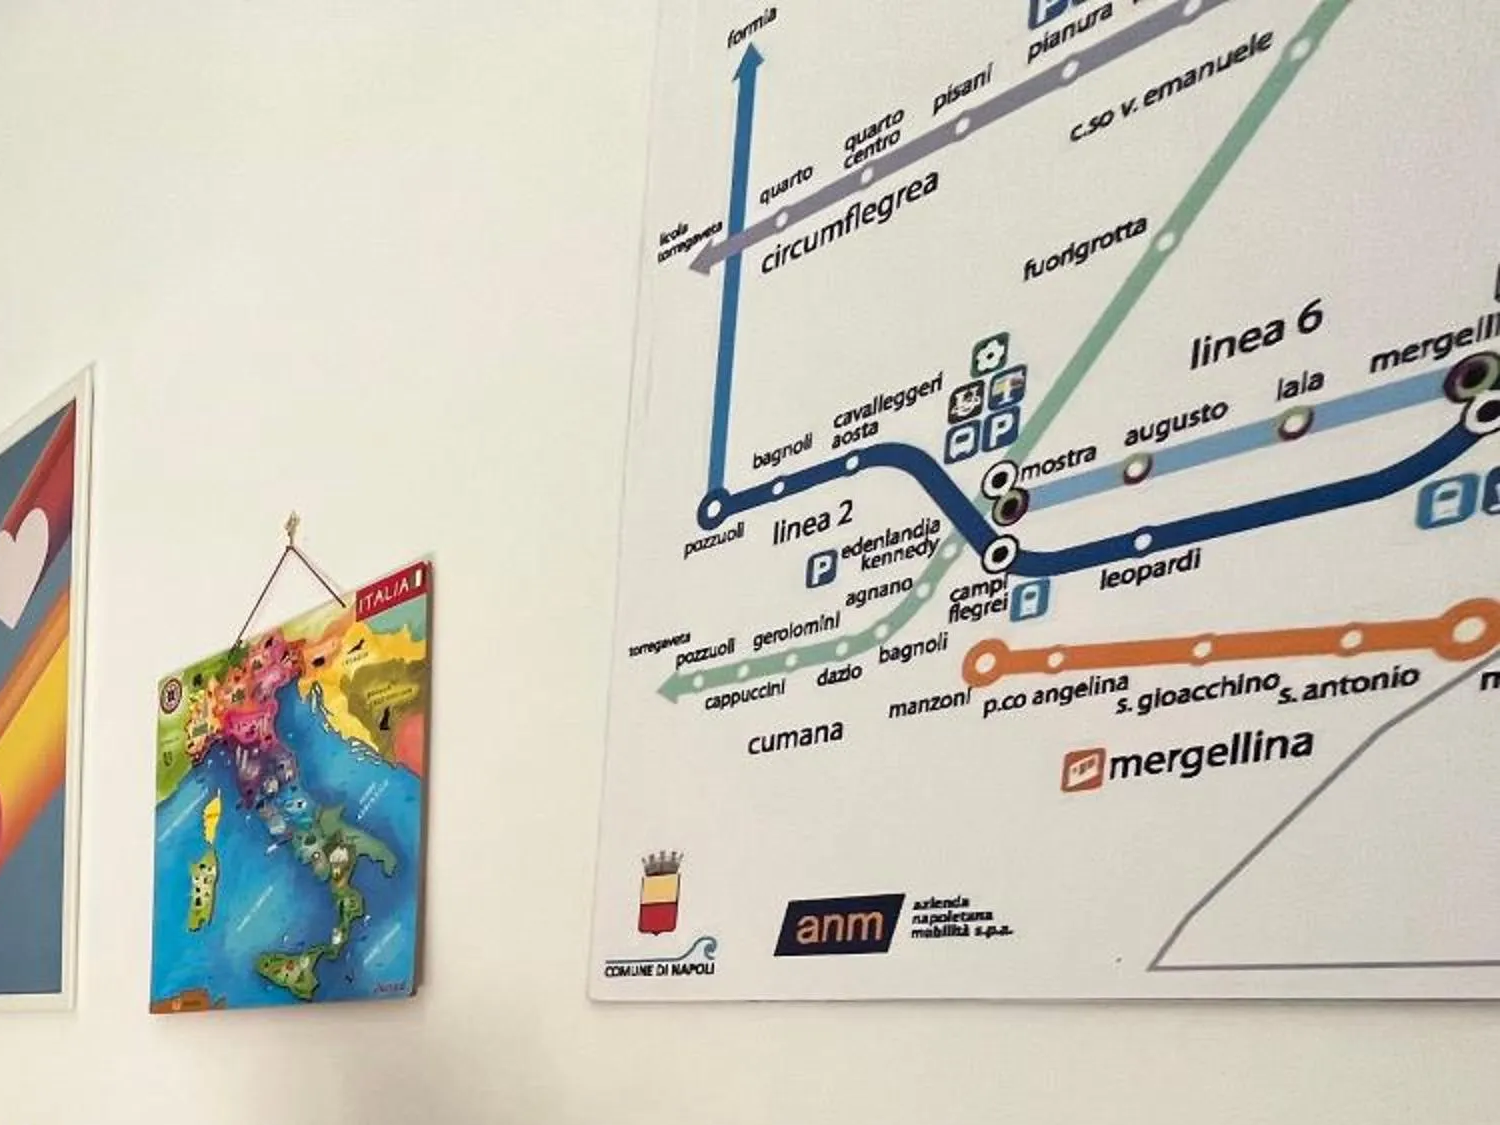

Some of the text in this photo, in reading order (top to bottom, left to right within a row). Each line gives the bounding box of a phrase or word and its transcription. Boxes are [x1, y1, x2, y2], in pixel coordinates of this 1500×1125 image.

[727, 7, 777, 48] formia
[1027, 2, 1113, 64] pianura
[932, 62, 994, 116] pisani
[1070, 30, 1274, 142] c.so v. emanuele
[843, 129, 901, 169] centro
[845, 109, 905, 151] quarto
[759, 165, 813, 204] quarto
[760, 171, 939, 274] circumflegrea
[1023, 216, 1148, 282] fuorigrotta
[1190, 299, 1325, 370] linea 6
[833, 371, 944, 429] cavalleggeri
[831, 420, 879, 450] aosta
[1123, 400, 1229, 446] augusto
[753, 432, 813, 469] bagnoli
[1020, 445, 1097, 483] mostra
[683, 521, 745, 558] pozzuoli
[772, 500, 854, 546] linea 2
[841, 517, 941, 560] edenlandia
[860, 538, 941, 573] kennedy
[1099, 548, 1202, 590] leopardi
[357, 577, 409, 614] ITALIA
[845, 577, 914, 608] agnano
[949, 572, 1009, 603] campi
[949, 592, 1009, 624] flegrei
[753, 611, 841, 650] gerolomini
[878, 632, 949, 664] bagnoli
[675, 637, 736, 670] pozzuoli
[704, 678, 786, 711] cappuccini
[816, 664, 863, 687] dazio
[983, 671, 1130, 718] p.co angelina
[1116, 670, 1281, 716] s. gioacchino
[1277, 664, 1421, 706] s. antonio
[888, 686, 972, 719] manzoni
[748, 721, 845, 755] cumana
[1109, 730, 1315, 779] mergellina
[911, 910, 993, 926] napoletana
[913, 896, 970, 911] azienda
[796, 911, 884, 945] anm
[911, 923, 970, 939] mobilità
[604, 961, 715, 977] COMUNE DI NAPOLI
